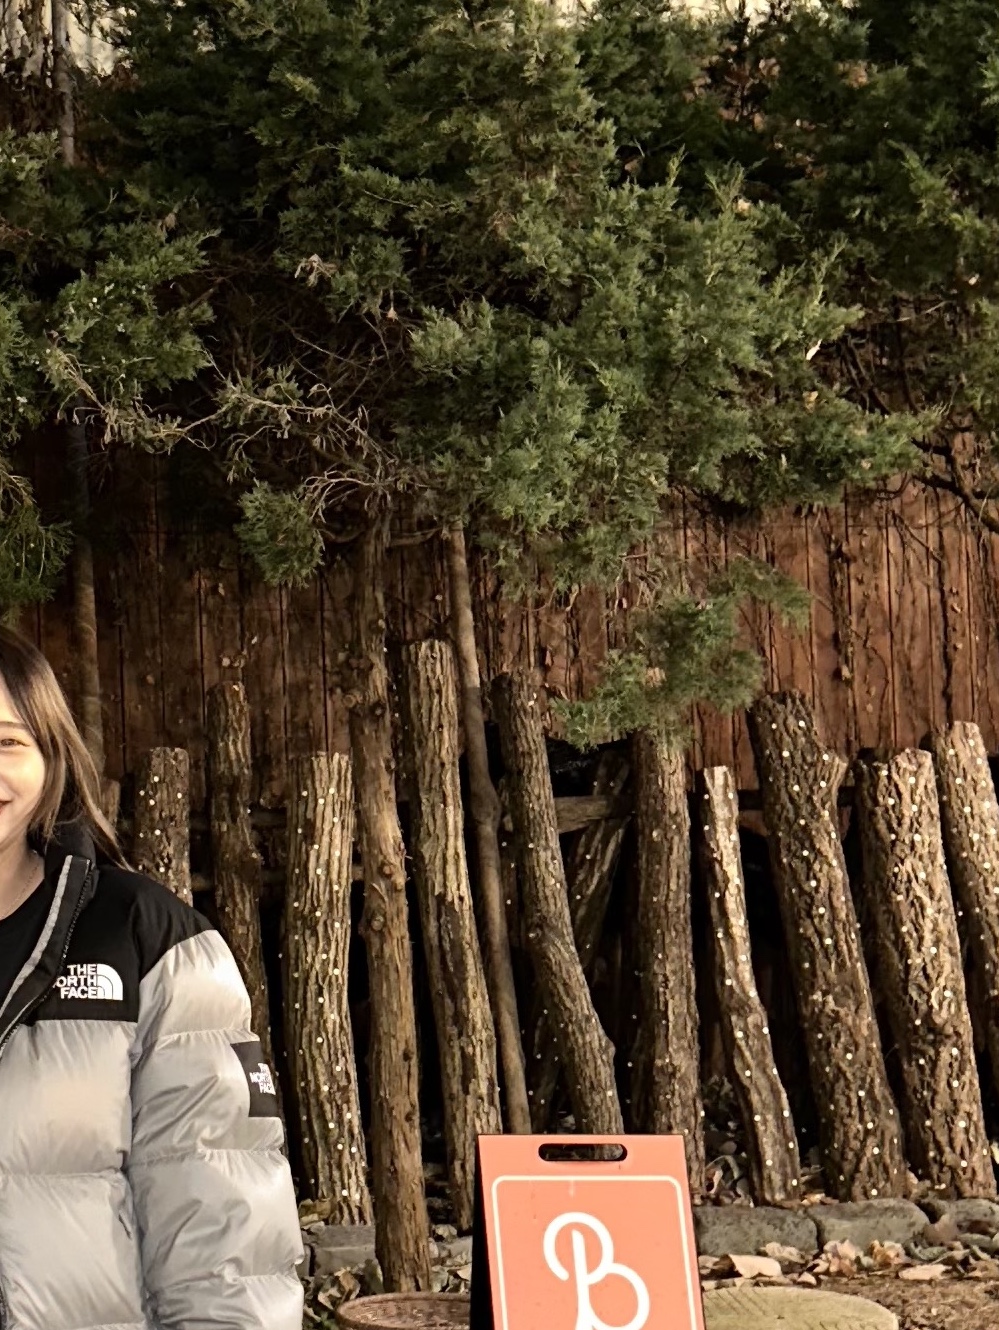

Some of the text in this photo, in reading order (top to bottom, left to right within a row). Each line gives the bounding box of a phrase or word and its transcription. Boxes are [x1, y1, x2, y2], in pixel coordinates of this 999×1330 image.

[67, 964, 97, 976] THE
[53, 975, 97, 988] ORTH
[61, 986, 98, 999] FACE
